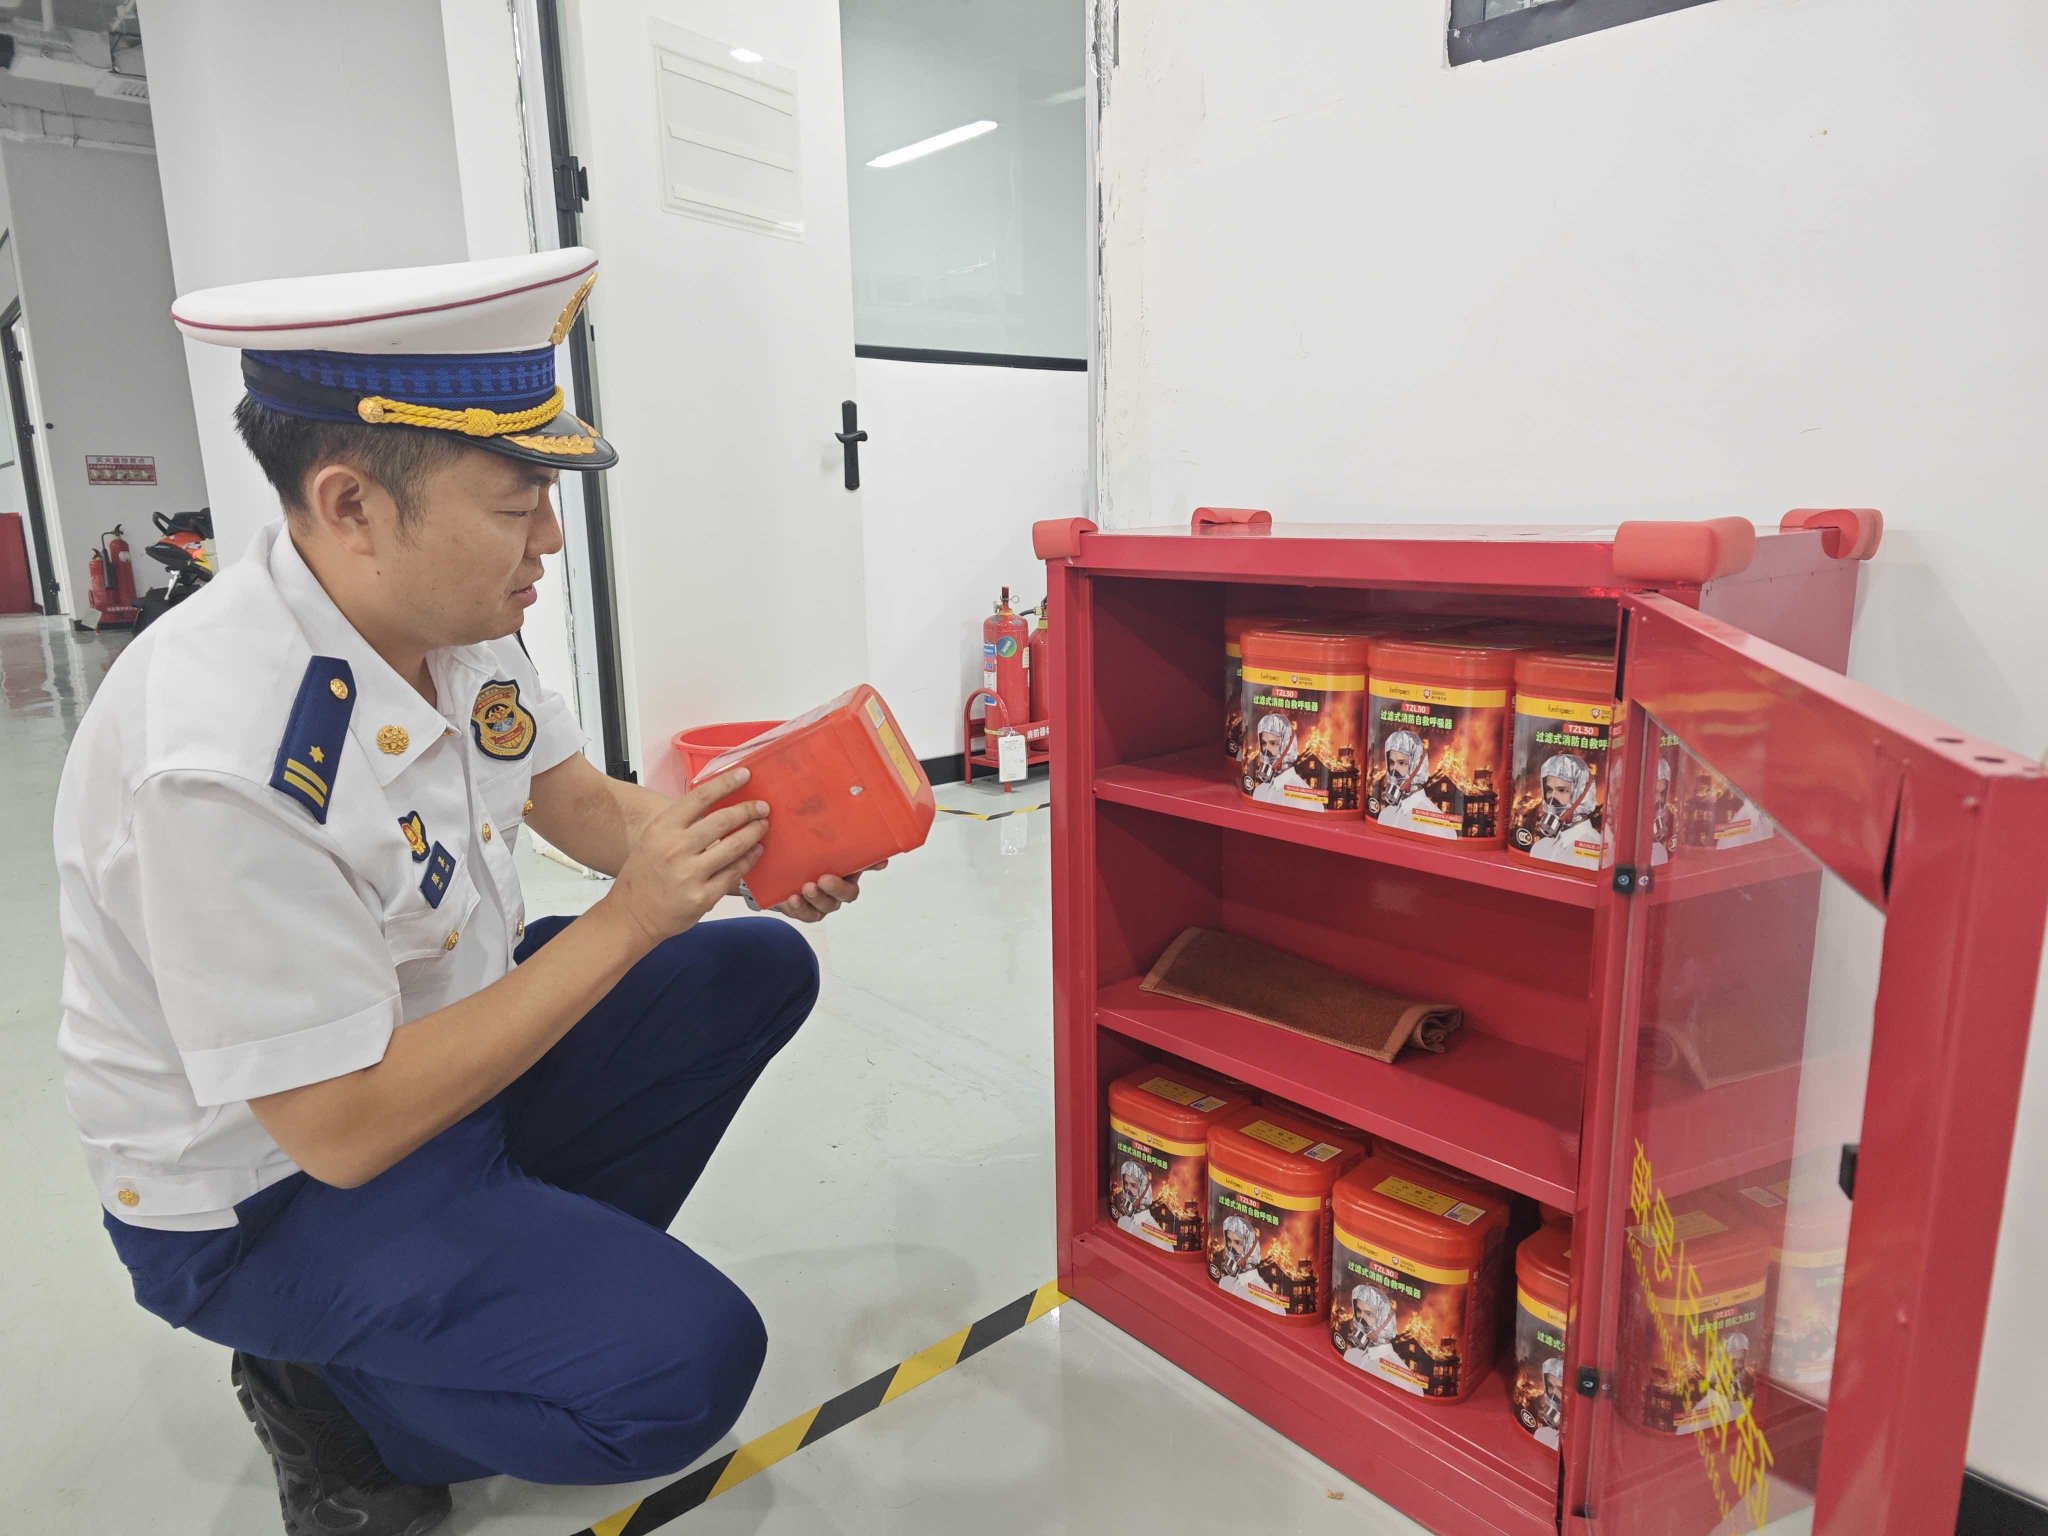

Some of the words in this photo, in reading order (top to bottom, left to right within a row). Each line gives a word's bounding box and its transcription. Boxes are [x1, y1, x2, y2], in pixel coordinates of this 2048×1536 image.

[1275, 688, 1294, 698] TZL30
[1253, 694, 1319, 712] 过滤式消防自救呼吸器
[1405, 703, 1426, 714] TZL30
[1380, 710, 1453, 730] 过滤式消防自救呼吸器
[1568, 724, 1594, 735] TZL30
[1239, 1195, 1257, 1208] TZL30
[1218, 1195, 1280, 1226] 过滤式消防自救呼吸器
[1372, 1262, 1395, 1278] TZL30
[1347, 1260, 1421, 1300] 过滤式消防自救呼吸器
